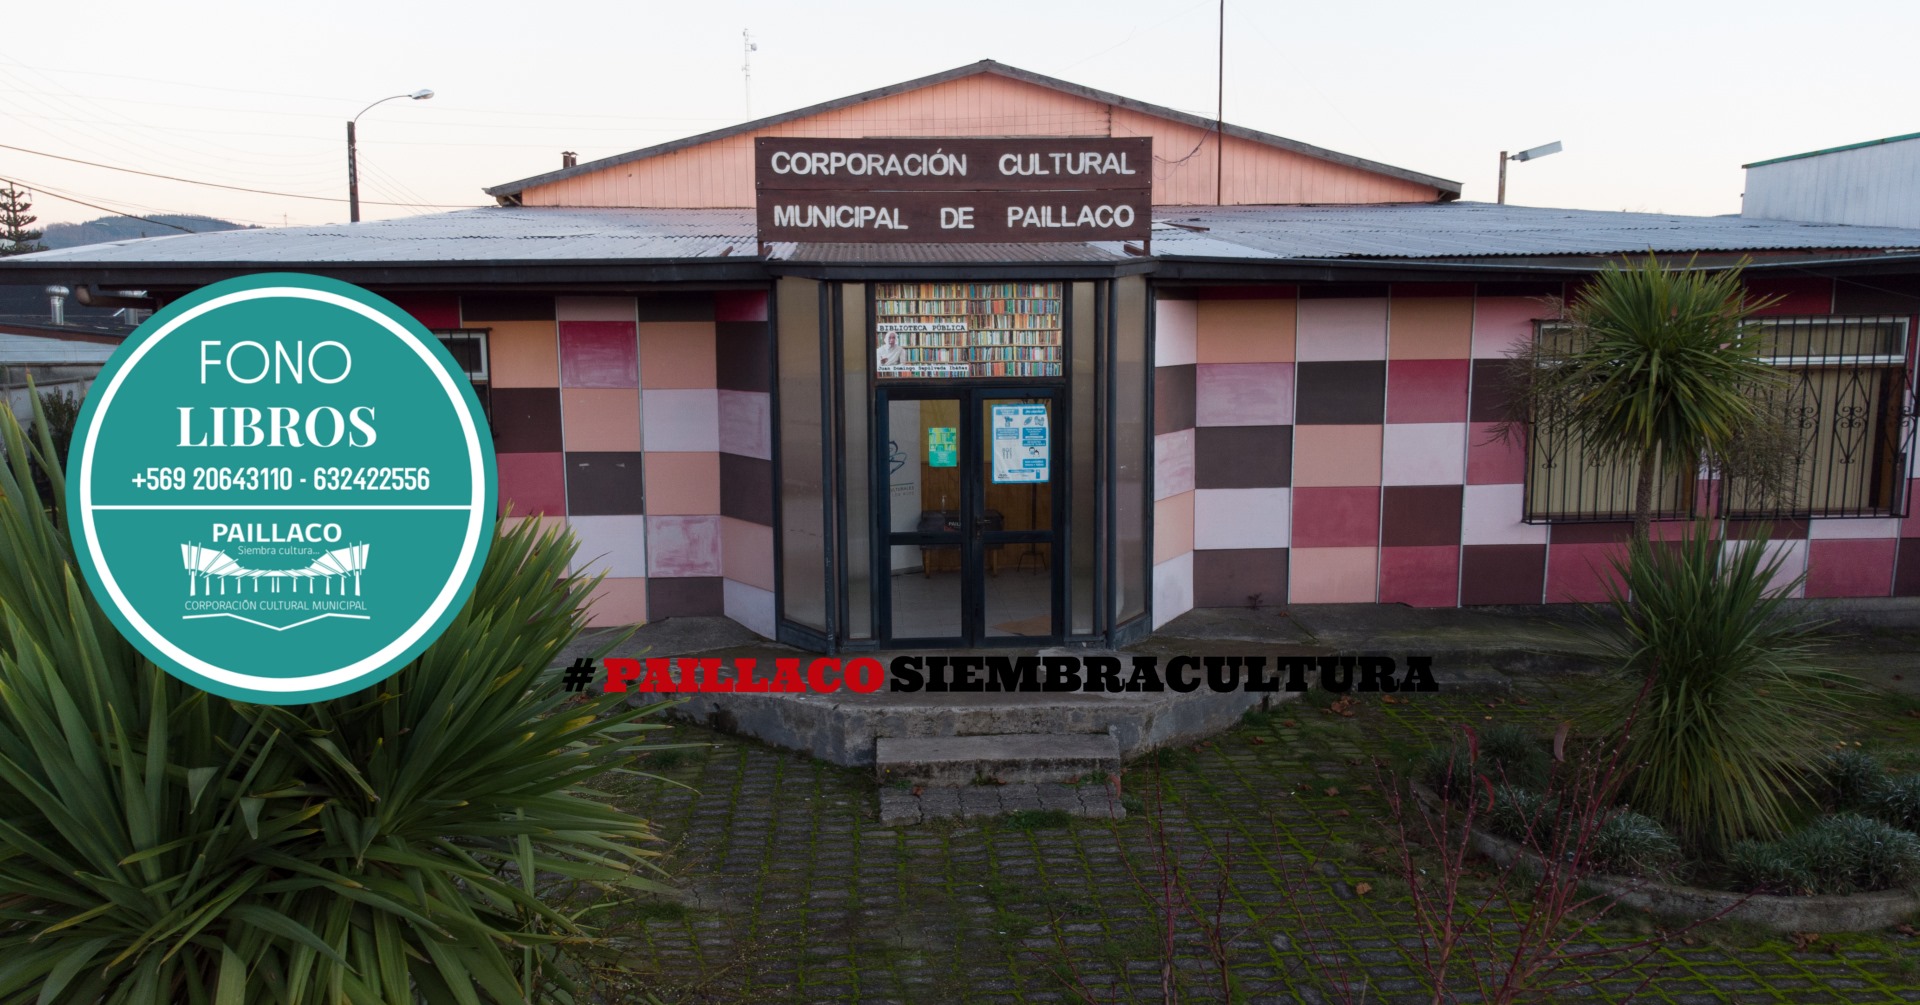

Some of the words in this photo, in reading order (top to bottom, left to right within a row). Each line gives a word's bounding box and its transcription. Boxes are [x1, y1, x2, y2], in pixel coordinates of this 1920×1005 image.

[771, 148, 967, 176] CORPORACIÓN
[999, 152, 1135, 175] CULTURAL
[774, 205, 908, 229] MUNICIPAL
[940, 207, 974, 229] DE
[1007, 205, 1135, 228] PAILLACO
[932, 323, 966, 331] PÚBLICA
